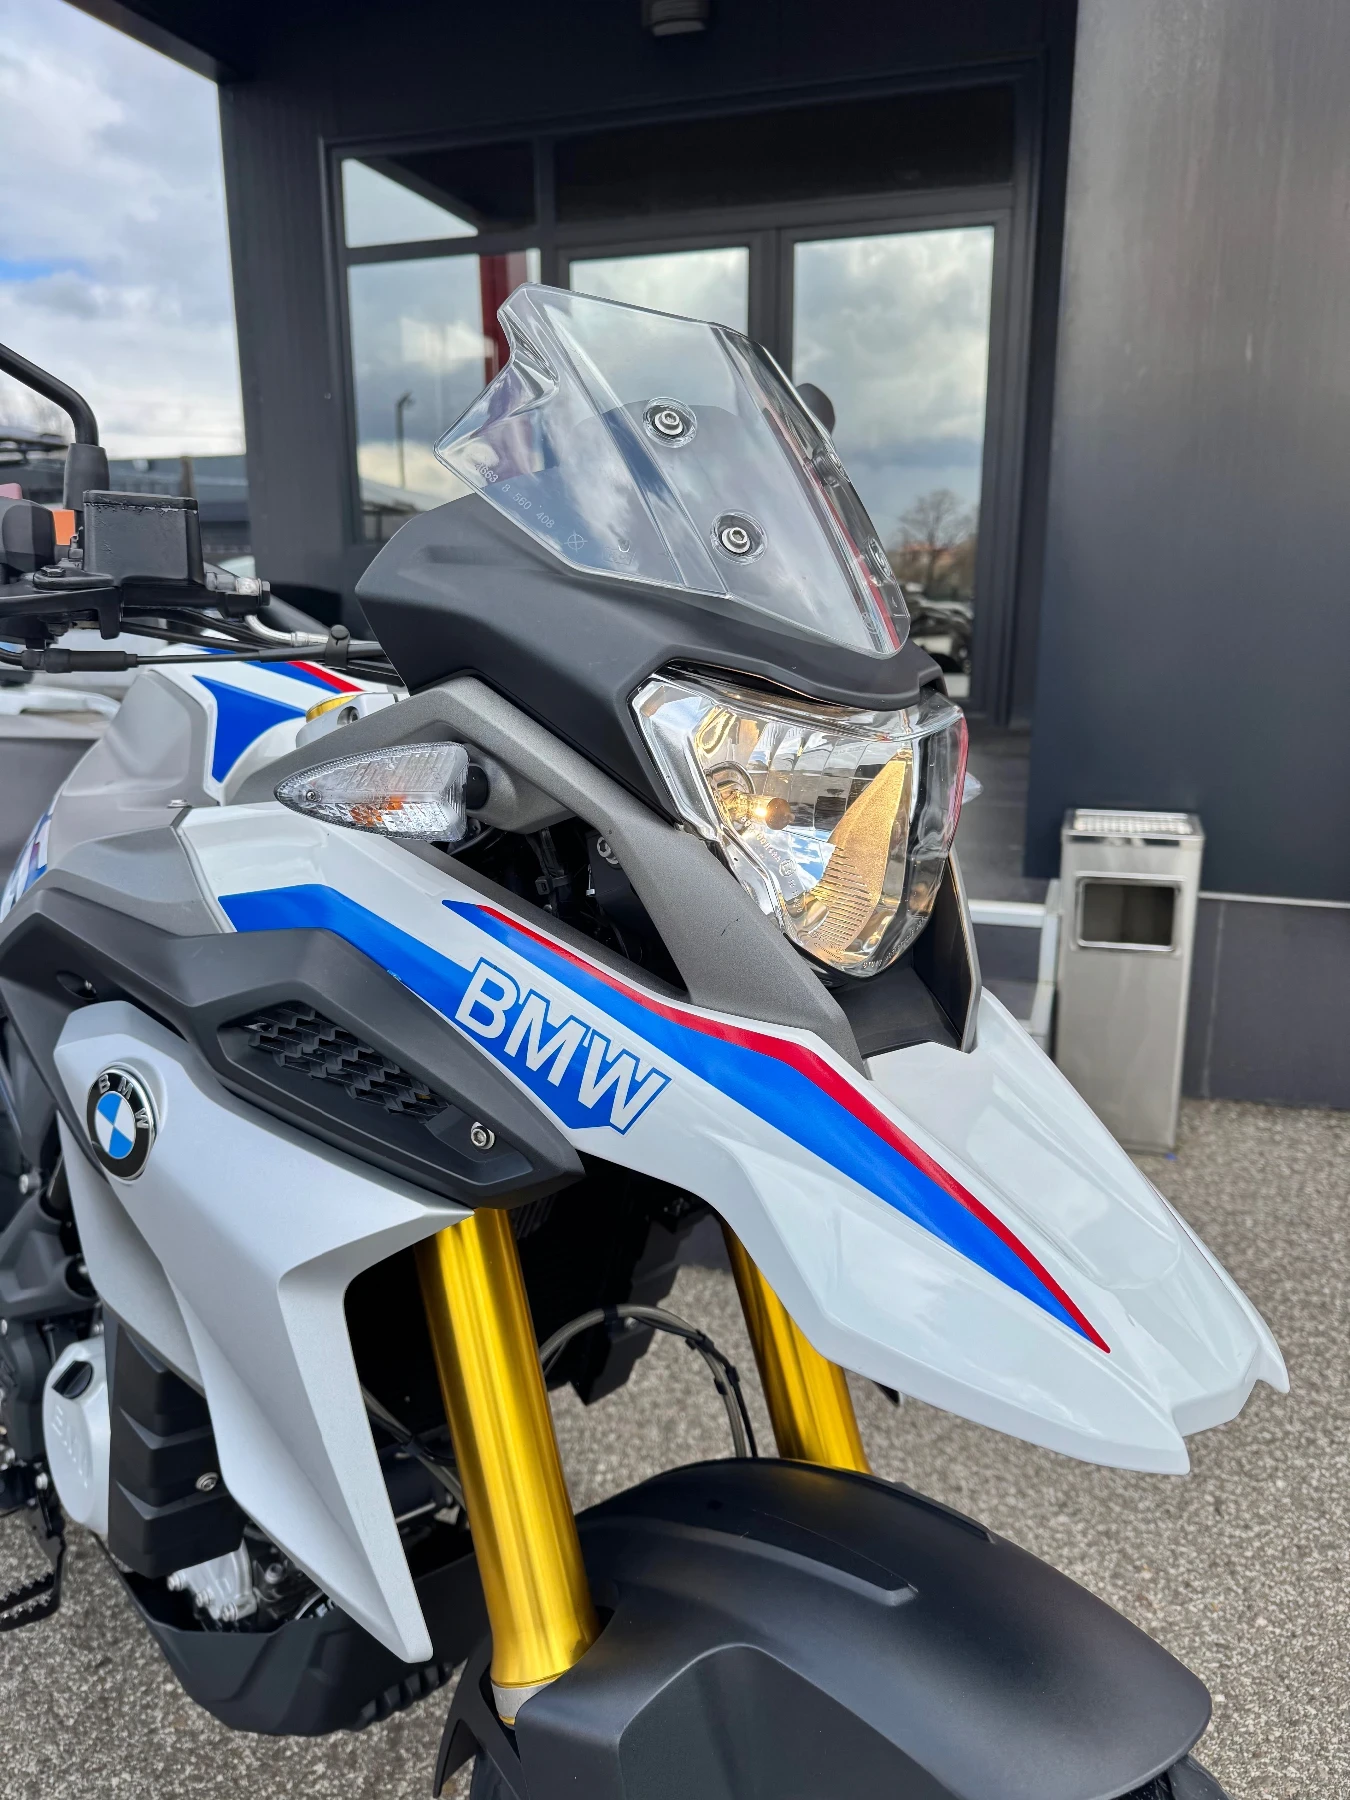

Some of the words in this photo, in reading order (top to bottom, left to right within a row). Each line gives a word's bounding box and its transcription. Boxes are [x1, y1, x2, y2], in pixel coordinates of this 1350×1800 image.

[501, 483, 511, 493] 8
[512, 492, 532, 510] 560
[536, 512, 555, 529] 408
[454, 958, 672, 1135] BMW
[98, 1074, 150, 1129] BMW
